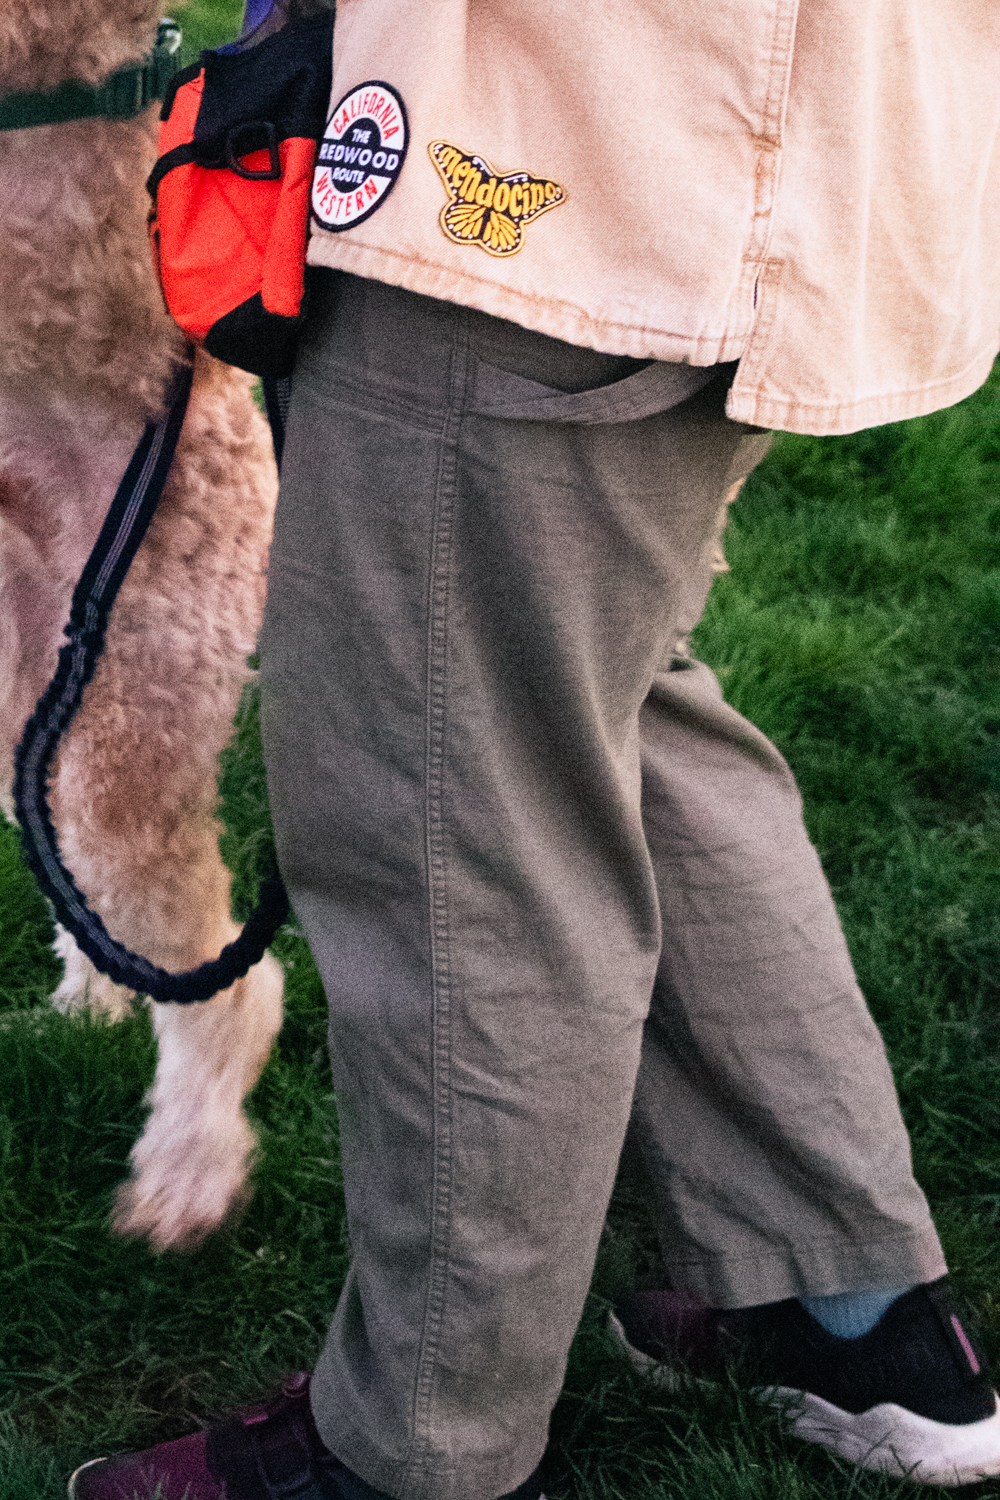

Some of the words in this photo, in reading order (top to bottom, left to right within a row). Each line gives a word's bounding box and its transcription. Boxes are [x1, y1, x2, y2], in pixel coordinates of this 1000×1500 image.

[333, 92, 400, 141] CALIFORNIA
[351, 128, 372, 144] THE
[319, 143, 400, 172] REDWOOD
[332, 166, 366, 184] ROUTE
[316, 170, 379, 219] WESTERN
